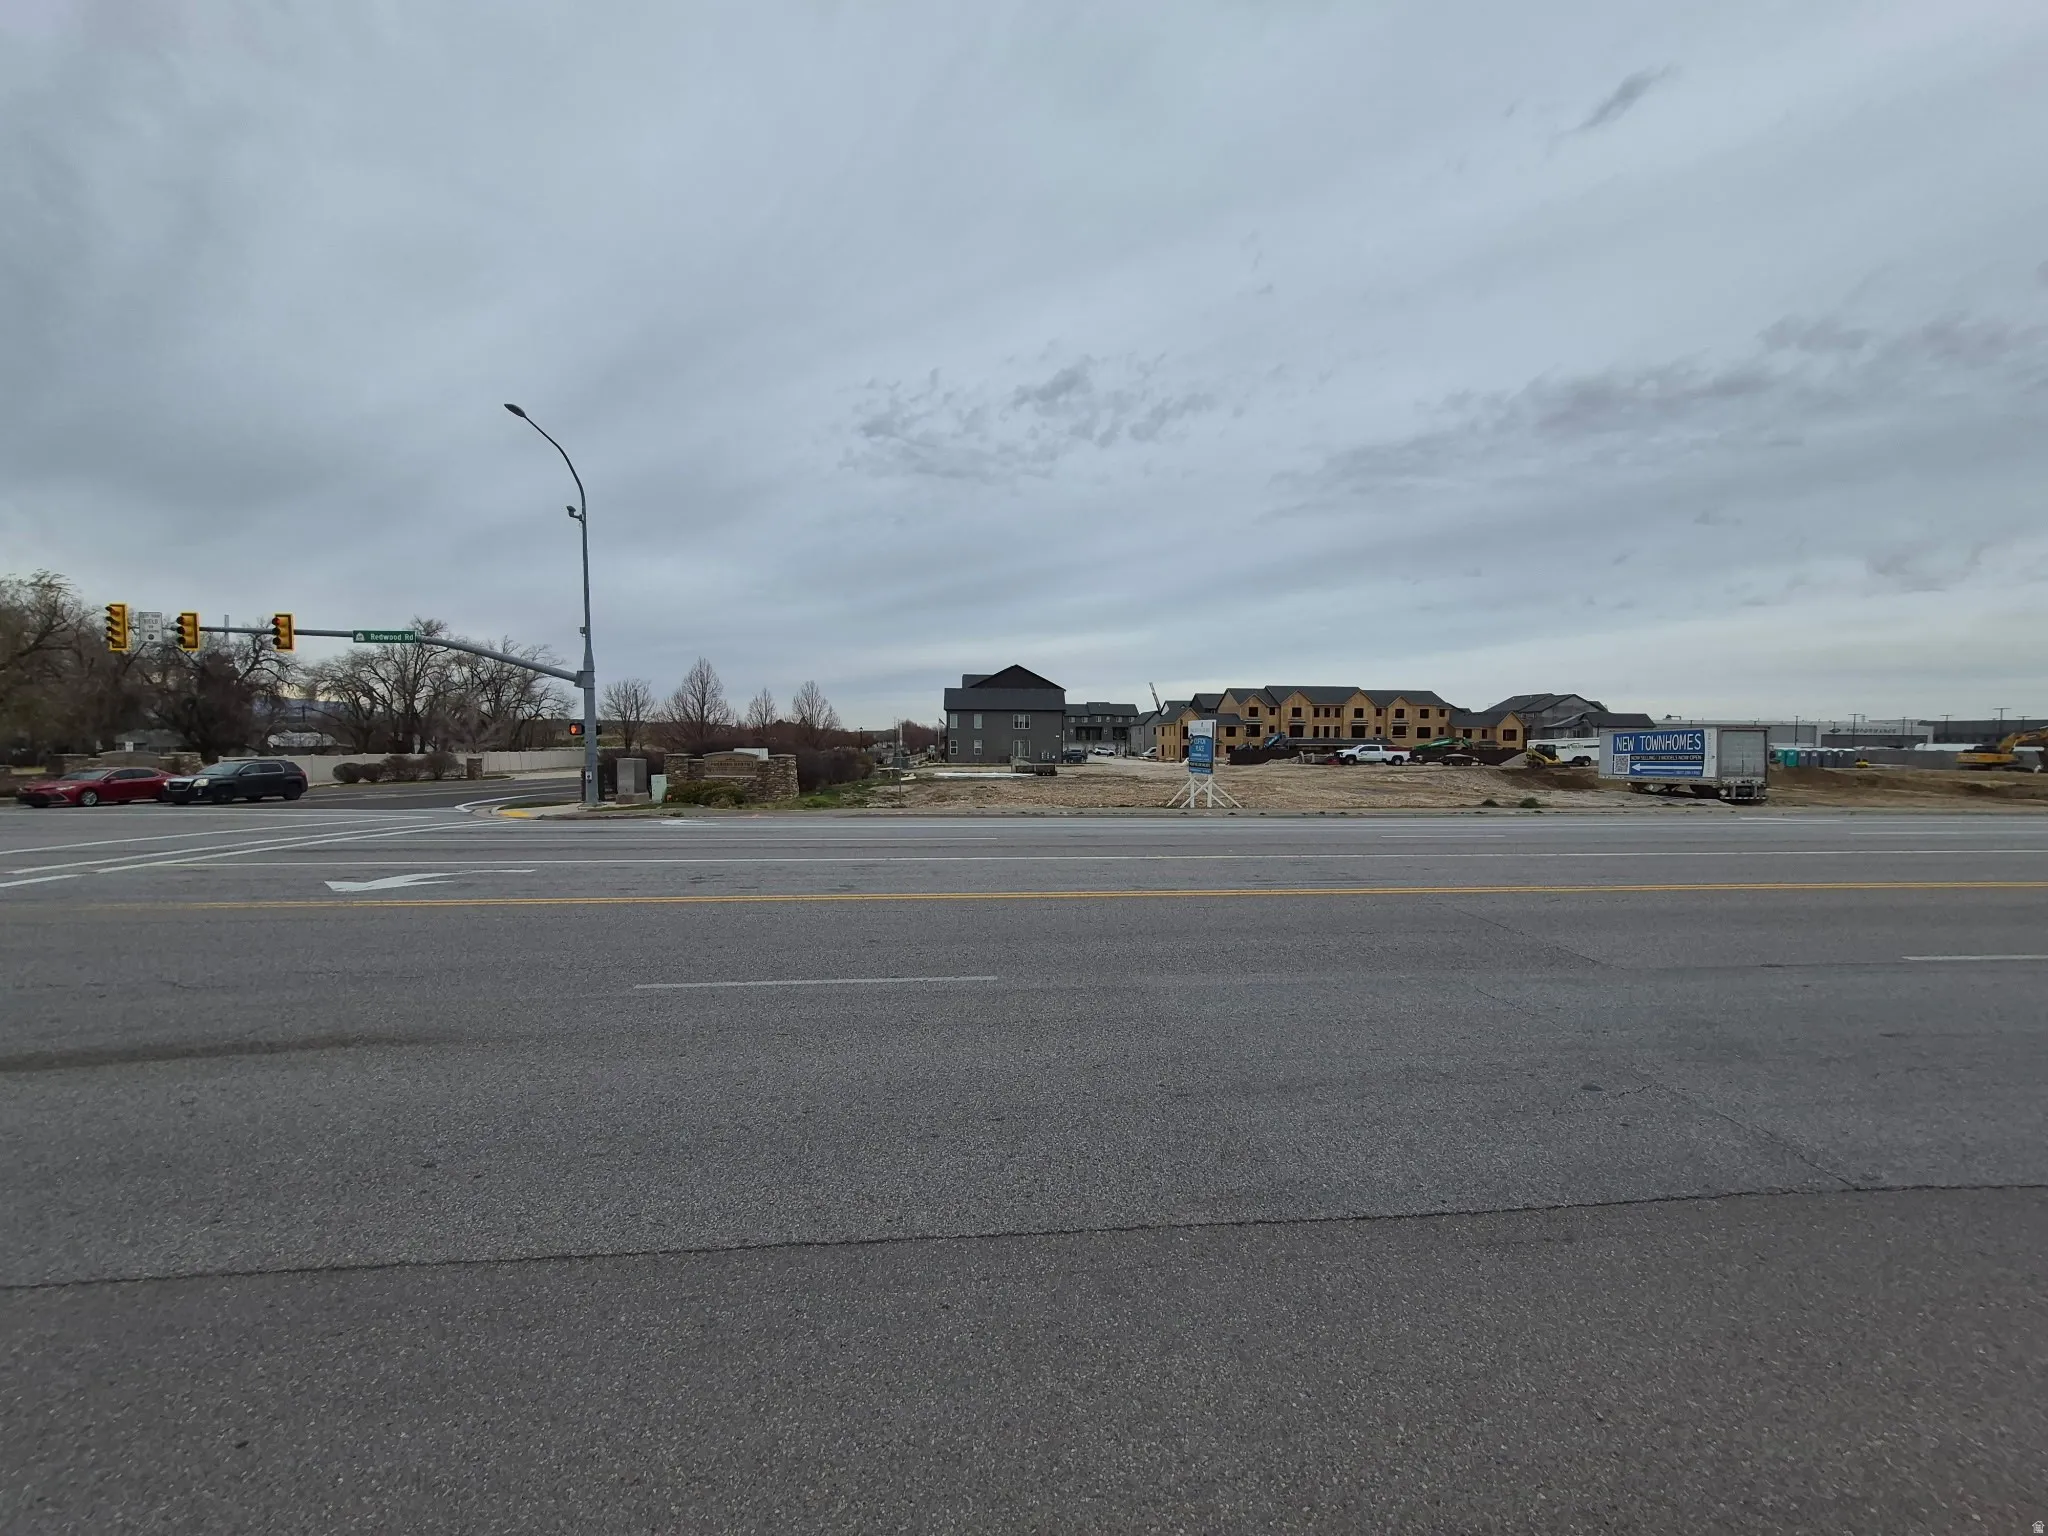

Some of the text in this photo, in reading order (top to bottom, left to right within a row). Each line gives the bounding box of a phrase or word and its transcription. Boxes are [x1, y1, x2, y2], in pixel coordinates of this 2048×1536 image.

[370, 633, 414, 641] Redwood Rd
[1616, 733, 1702, 752] NEW TOWNHOMES
